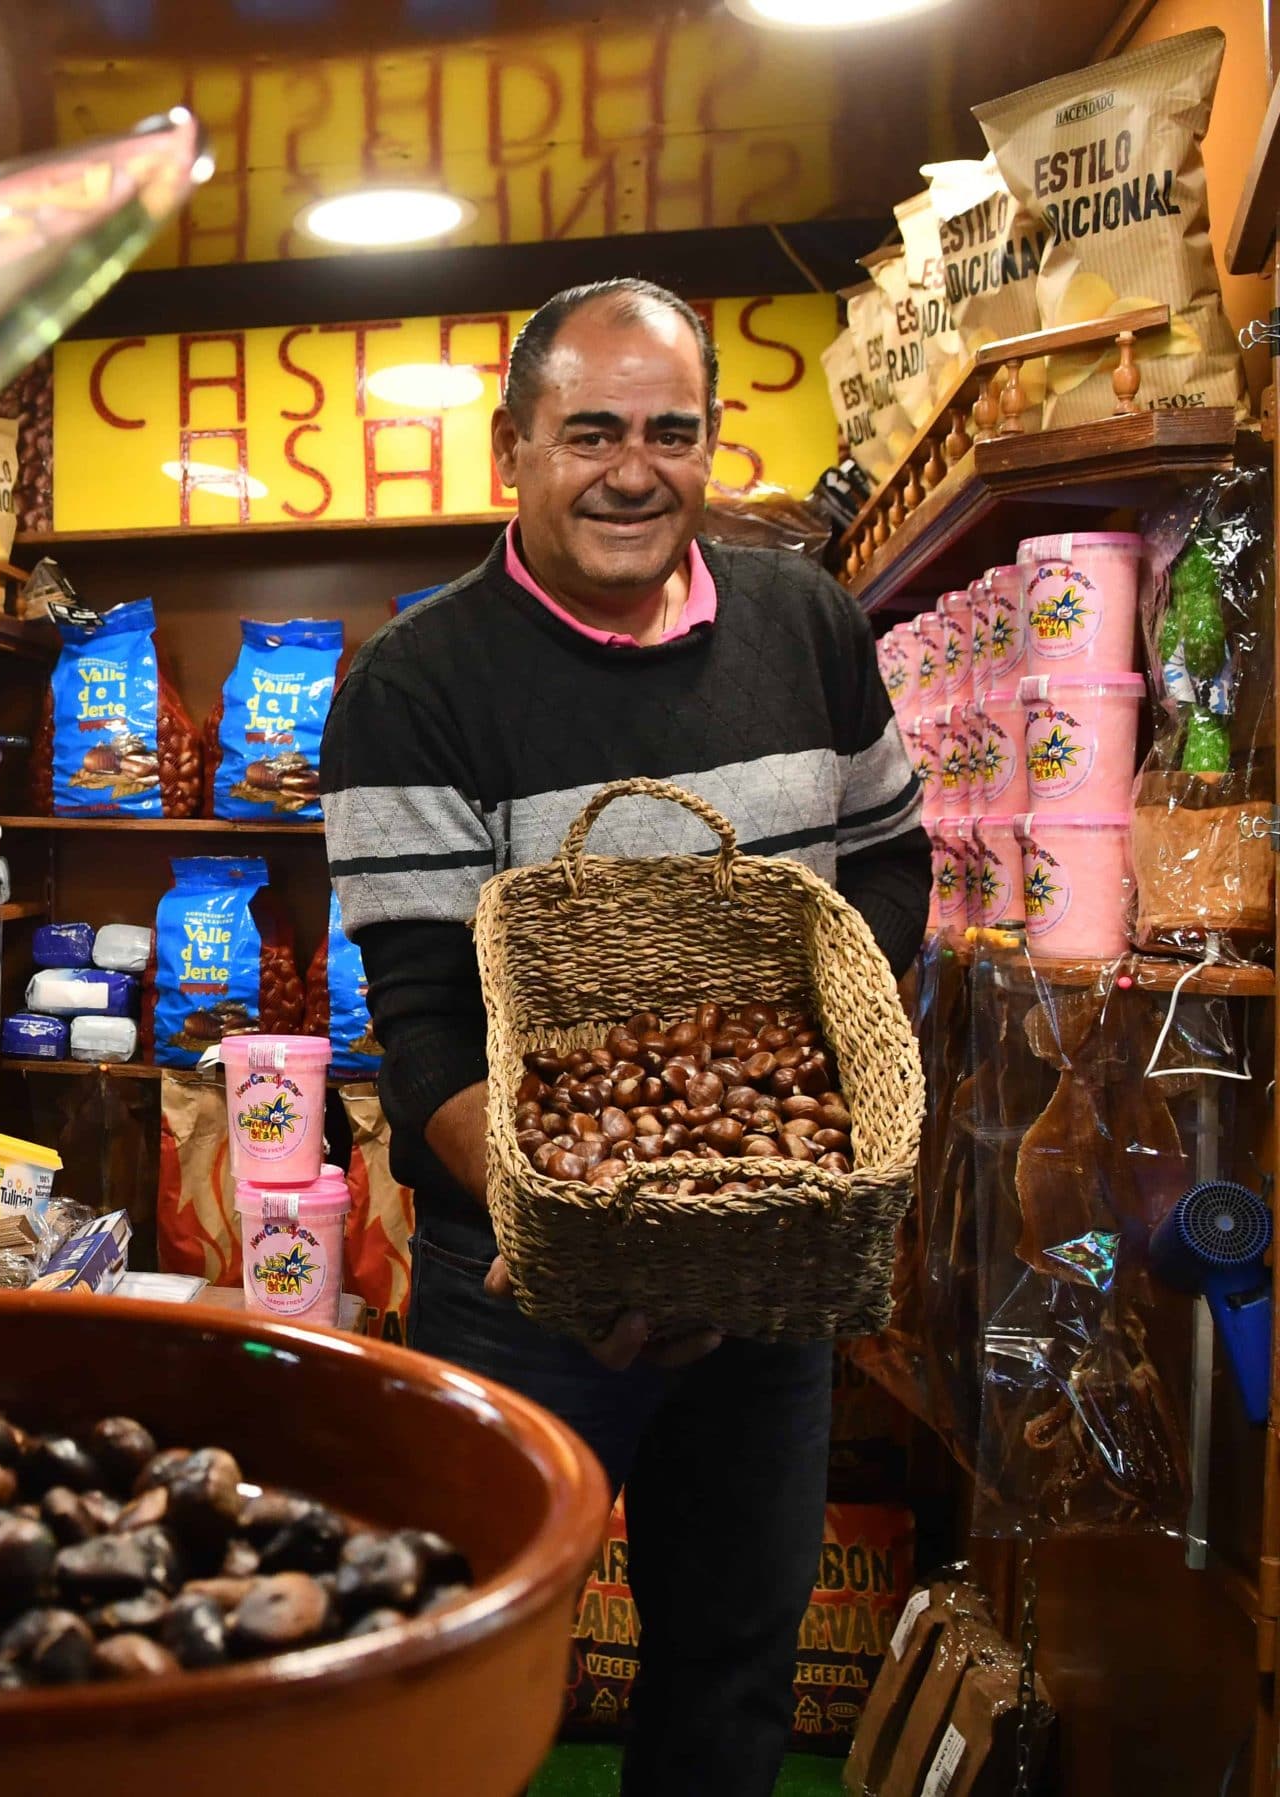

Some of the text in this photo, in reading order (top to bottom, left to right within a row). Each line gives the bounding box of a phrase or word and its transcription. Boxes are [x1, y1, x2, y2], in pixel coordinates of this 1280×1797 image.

[1056, 93, 1115, 125] HACENDADO
[1034, 130, 1132, 200] ESTILO
[1043, 170, 1181, 247] DICIONAL
[89, 297, 807, 430] CASTAS
[78, 667, 127, 684] Valle
[252, 677, 301, 695] Valle
[77, 701, 126, 720] Jerte
[245, 712, 296, 731] Jerte
[183, 924, 232, 943] Valle
[179, 962, 229, 981] Jerte
[235, 1073, 303, 1098] New Candy Star
[250, 1128, 278, 1141] Star
[0, 1186, 33, 1209] Tulipán
[250, 1223, 319, 1250] New Candy Star
[267, 1280, 295, 1293] Star
[817, 1538, 895, 1595] BÓN
